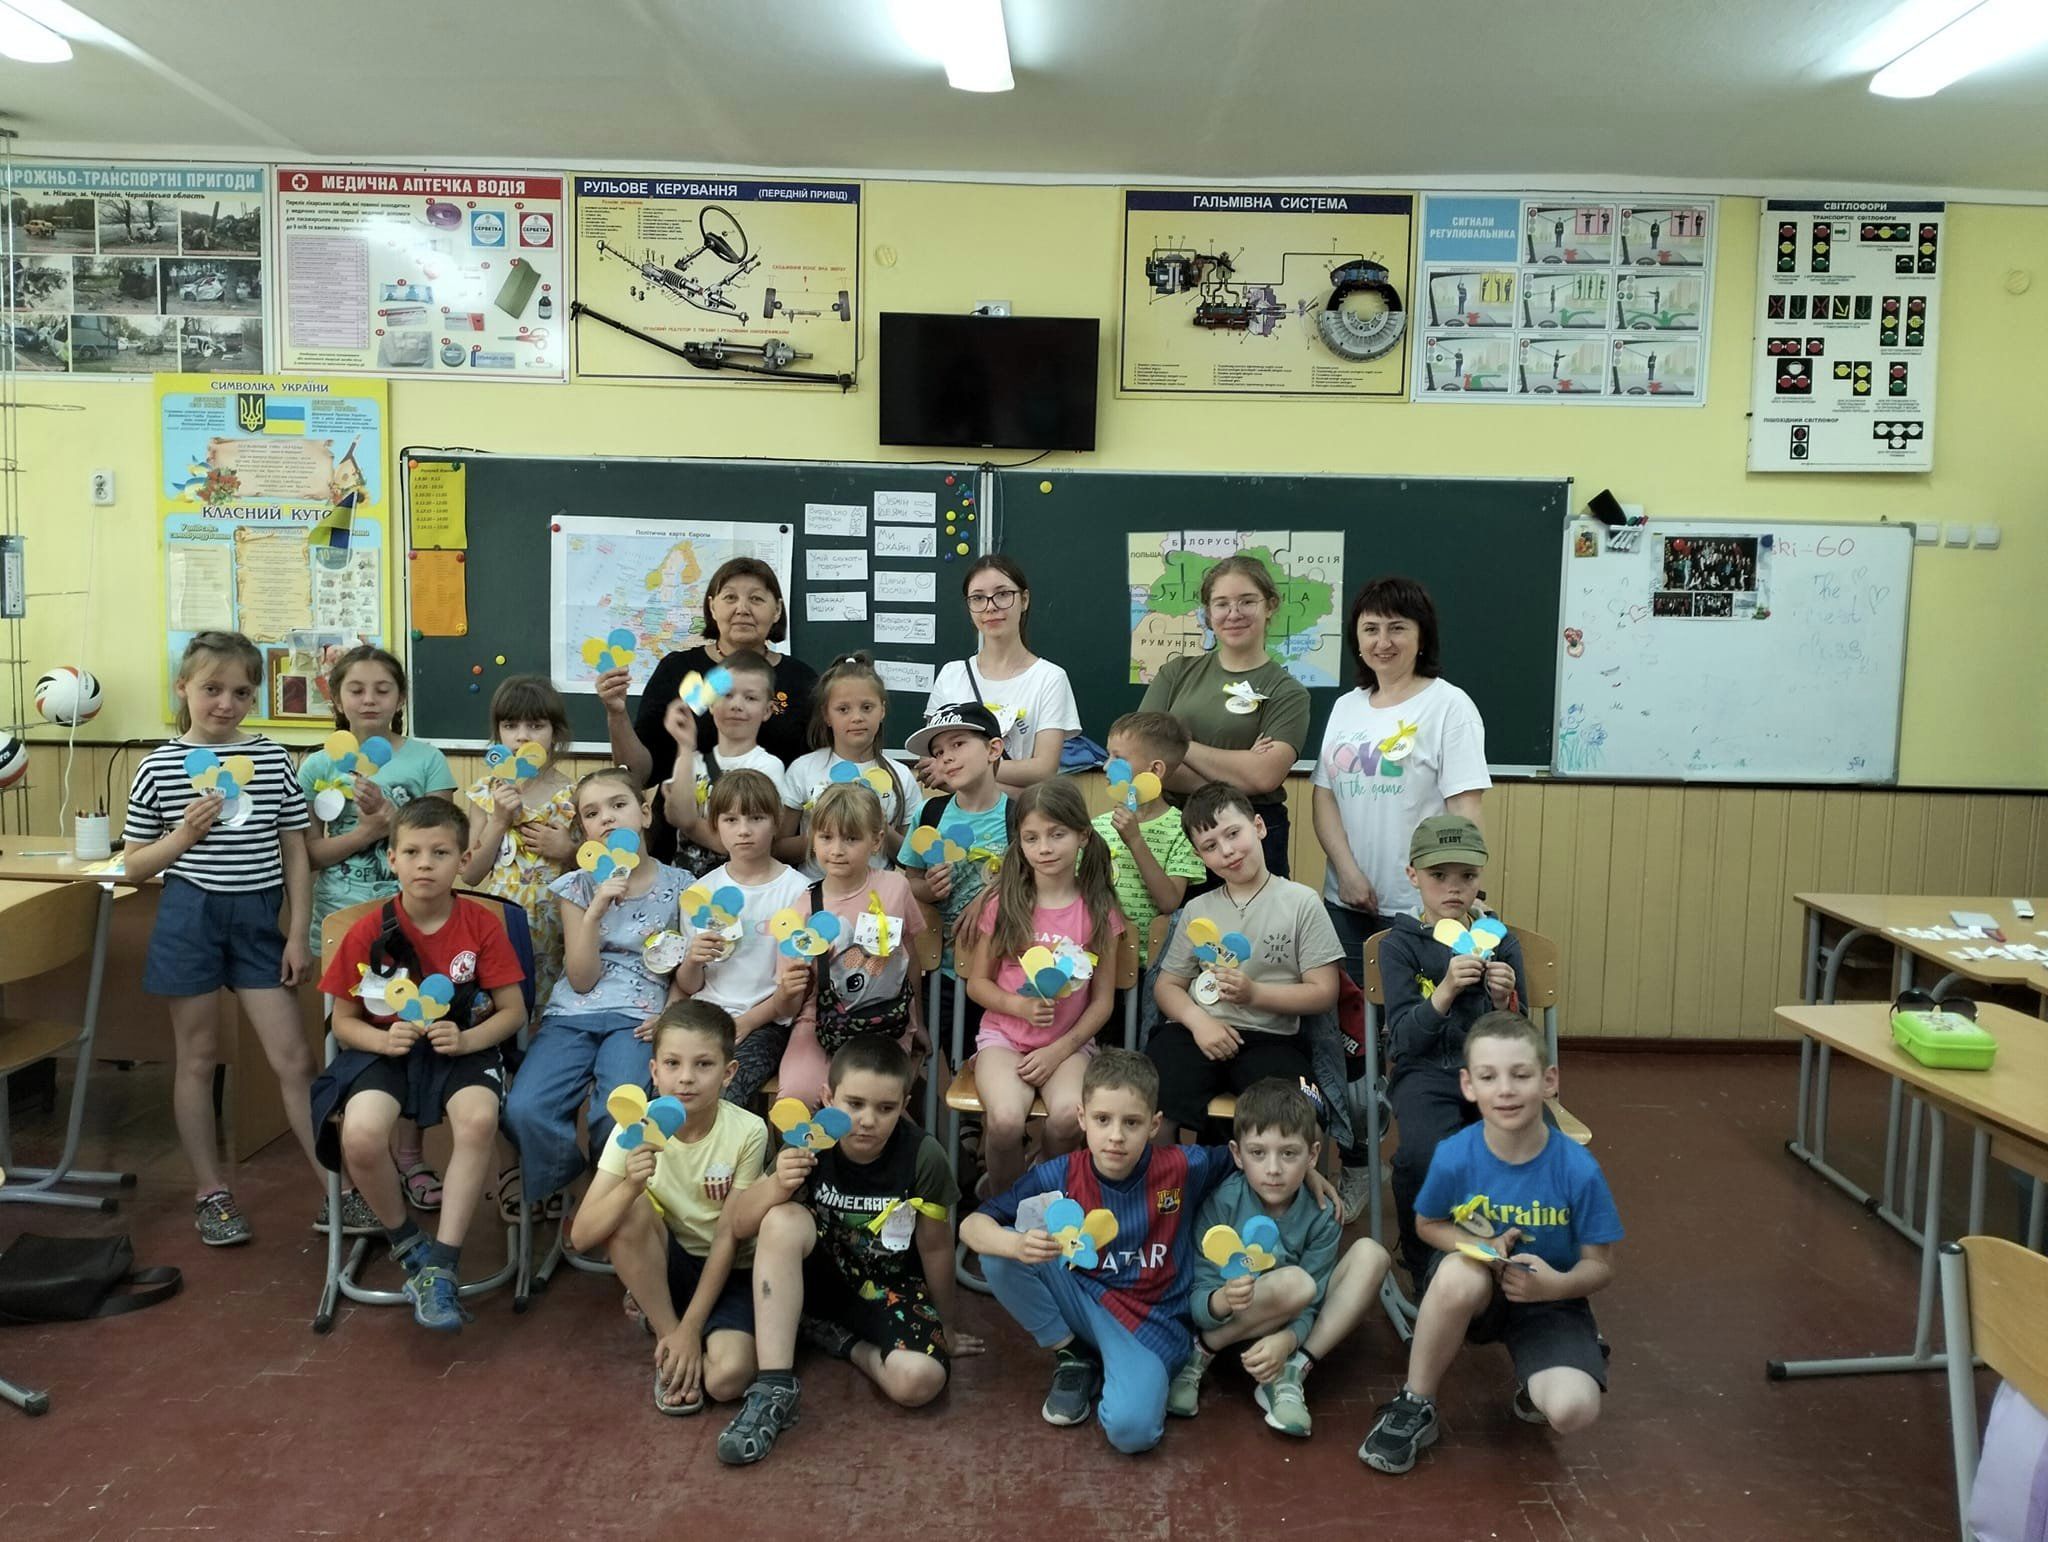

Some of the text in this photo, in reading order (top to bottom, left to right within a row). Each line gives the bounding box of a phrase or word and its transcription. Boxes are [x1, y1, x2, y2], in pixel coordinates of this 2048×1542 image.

[0, 169, 255, 189] ОРОЖНЬО-ТРАНСПОРТНІ ПРИГОДИ
[321, 175, 527, 196] МЕДИЧНА АПТЕЧКА ВОДІЯ
[583, 181, 848, 201] РУЛЬОВЕ КЕРУВАННЯ (ПЕРЕДНІЙ ПРИВІД)
[1192, 195, 1348, 210] ГАЛЬМІВНА СИСТЕМА
[1824, 202, 1887, 211] СВІТЛОФОРИ
[1452, 217, 1494, 227] СИГНАЛИ
[1429, 228, 1516, 239] РЕГУЛЮВАЛЬНИКА
[210, 380, 329, 392] СИМВОЛІКА УКРАЇНИ
[202, 505, 333, 521] КЛАСНИЙ КУТО
[1172, 537, 1240, 547] БІЛОРУСЬ
[1130, 551, 1162, 559] ПОЛЬЩА
[1297, 555, 1340, 564] РОСІЯ
[1141, 638, 1196, 648] РУМУНІЯ
[1271, 944, 1284, 952] THE
[1481, 1198, 1570, 1226] kraine
[1101, 1243, 1168, 1275] ATAR
